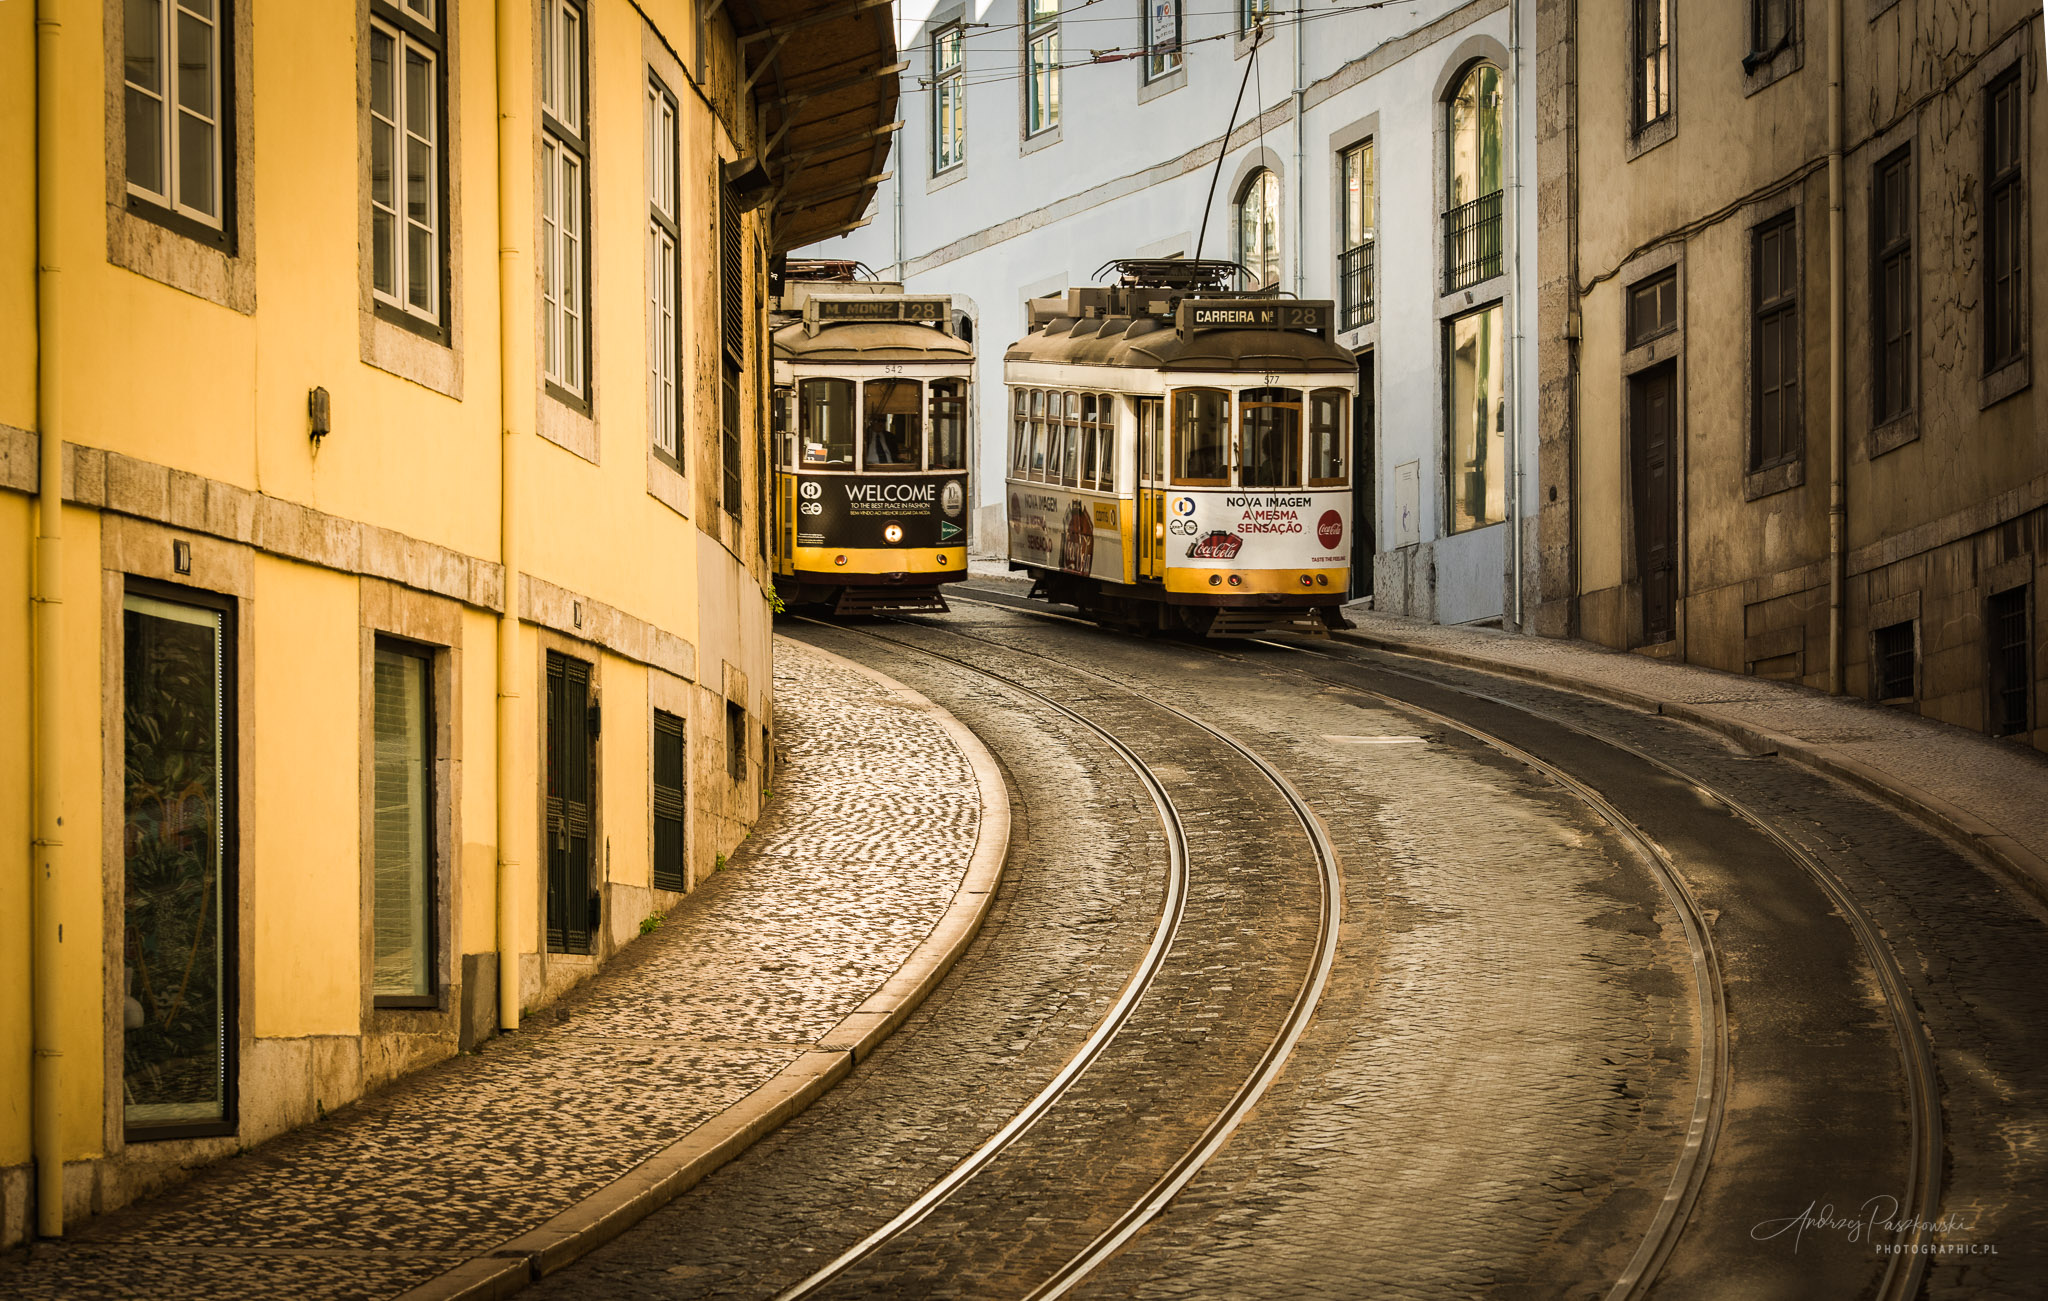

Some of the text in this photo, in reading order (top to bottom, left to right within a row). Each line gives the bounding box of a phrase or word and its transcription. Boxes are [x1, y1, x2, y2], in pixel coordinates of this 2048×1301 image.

[846, 303, 894, 314] MONIZ
[911, 303, 935, 319] 28
[1196, 310, 1255, 323] CARREIRA
[1291, 308, 1316, 325] 28
[884, 365, 903, 374] 542
[1264, 376, 1280, 385] 577
[844, 484, 936, 502] WELCOME
[1024, 493, 1058, 512] NOVA IMAGEM
[1226, 497, 1312, 507] NOVA IMAGEM
[1242, 510, 1298, 520] A MESMA
[1237, 520, 1302, 535] SENSAÇÃO
[1318, 522, 1342, 536] Coca-Cola
[1194, 542, 1238, 558] Coca-Cola
